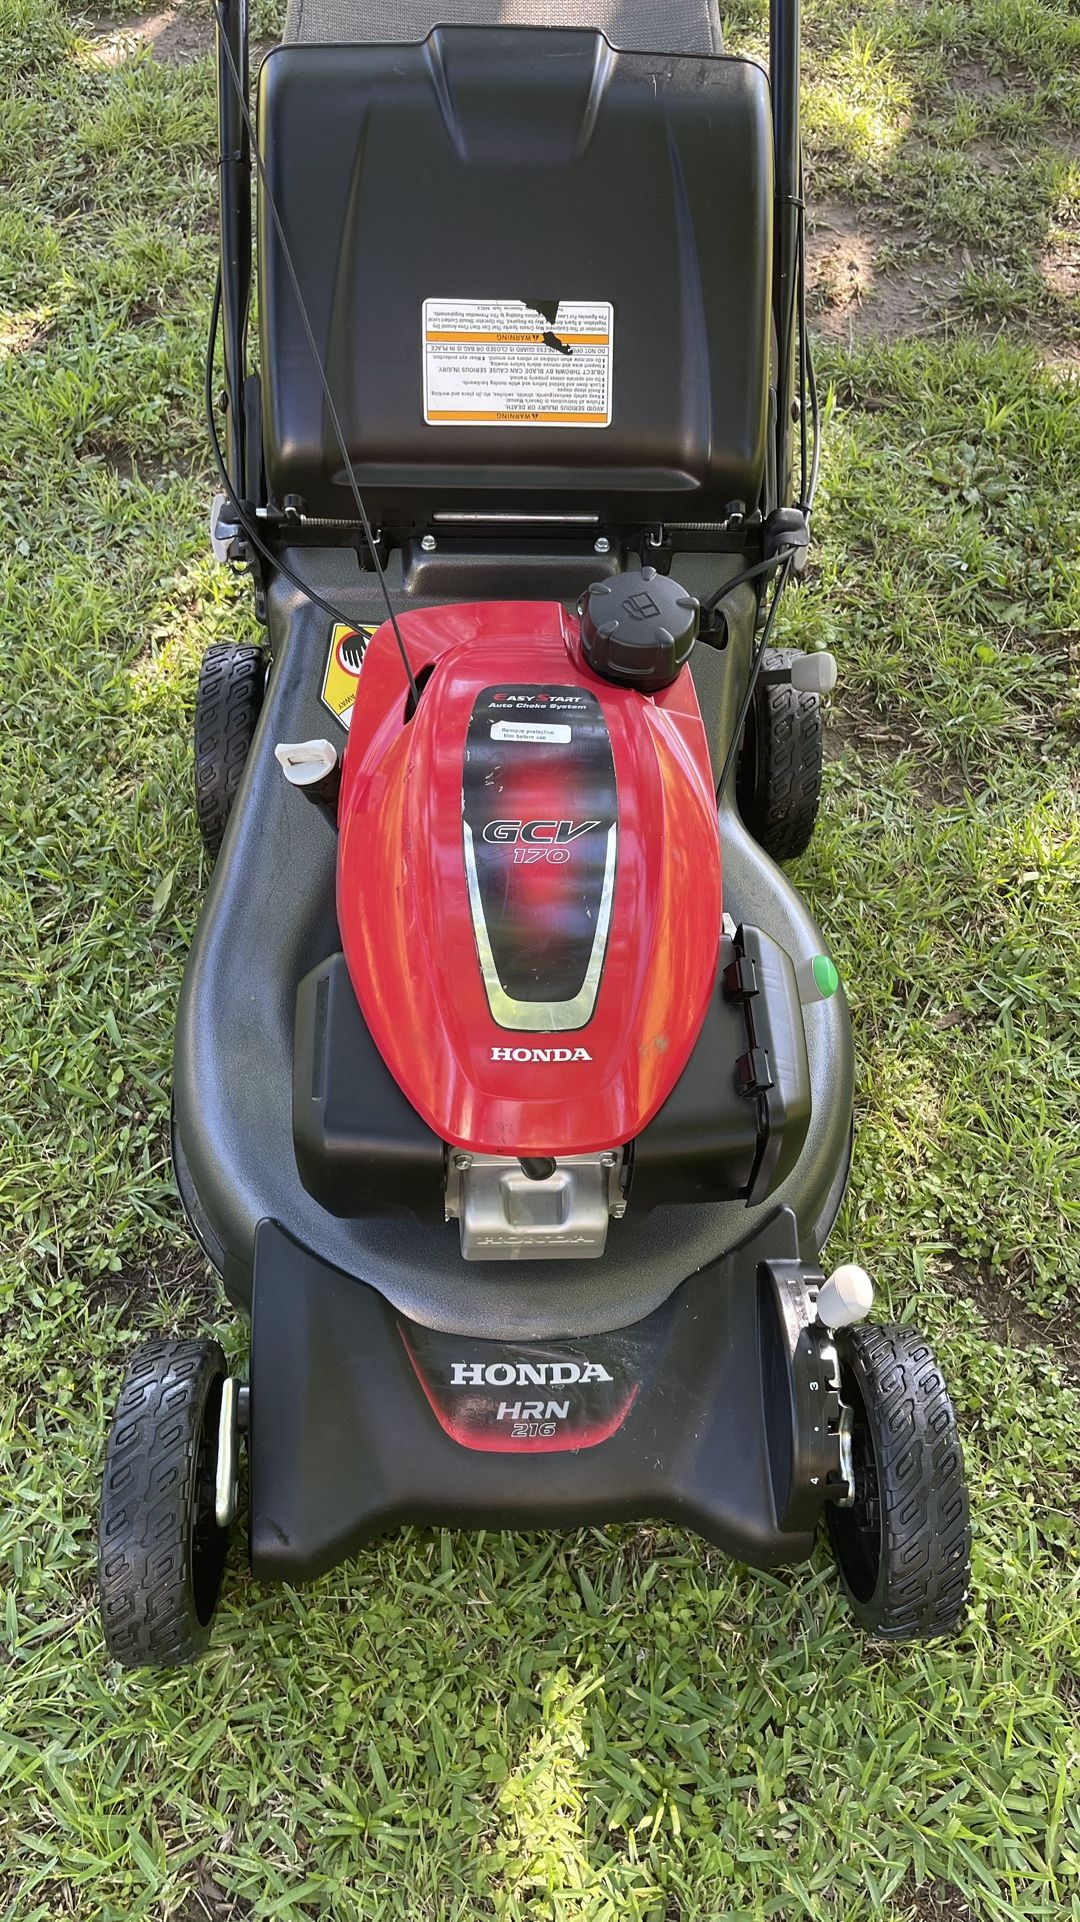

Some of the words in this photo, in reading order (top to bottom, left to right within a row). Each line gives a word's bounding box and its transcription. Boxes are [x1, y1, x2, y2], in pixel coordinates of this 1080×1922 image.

[494, 693, 535, 701] EASY
[536, 694, 582, 702] START
[482, 820, 602, 844] GCV
[514, 848, 570, 864] 170
[490, 1048, 592, 1062] HONDA
[450, 1362, 613, 1386] HONDA
[810, 1382, 819, 1390] 3
[496, 1400, 570, 1420] HRN
[511, 1422, 556, 1438] 216
